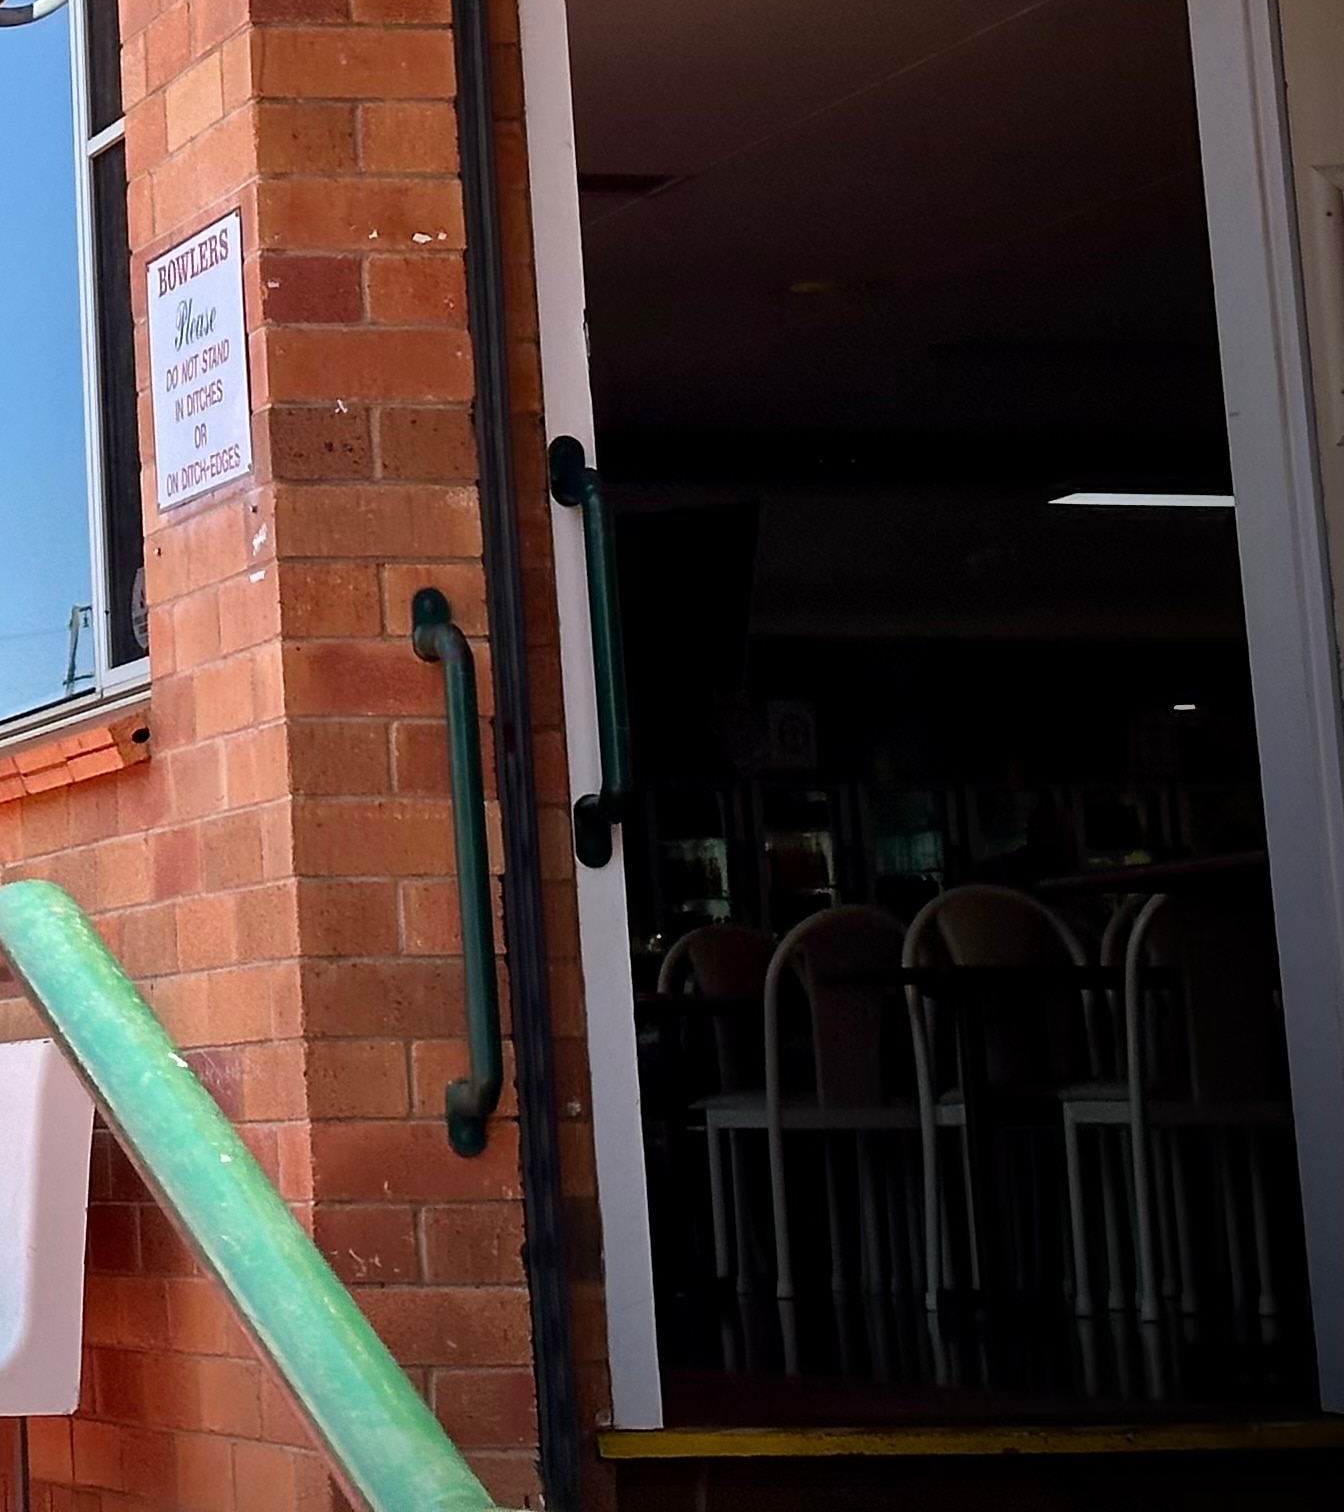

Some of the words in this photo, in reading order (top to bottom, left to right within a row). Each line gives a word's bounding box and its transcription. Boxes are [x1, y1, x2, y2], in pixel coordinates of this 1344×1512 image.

[158, 228, 229, 298] BOWLERS
[175, 298, 217, 351] Please
[166, 365, 179, 392] DO
[181, 354, 199, 384] NOT
[201, 339, 230, 374] STAND
[175, 396, 184, 422] IN
[186, 379, 223, 417] DITCHES
[194, 422, 207, 449] OR
[166, 473, 179, 497] ON
[181, 443, 241, 491] DITCH-EDGES
